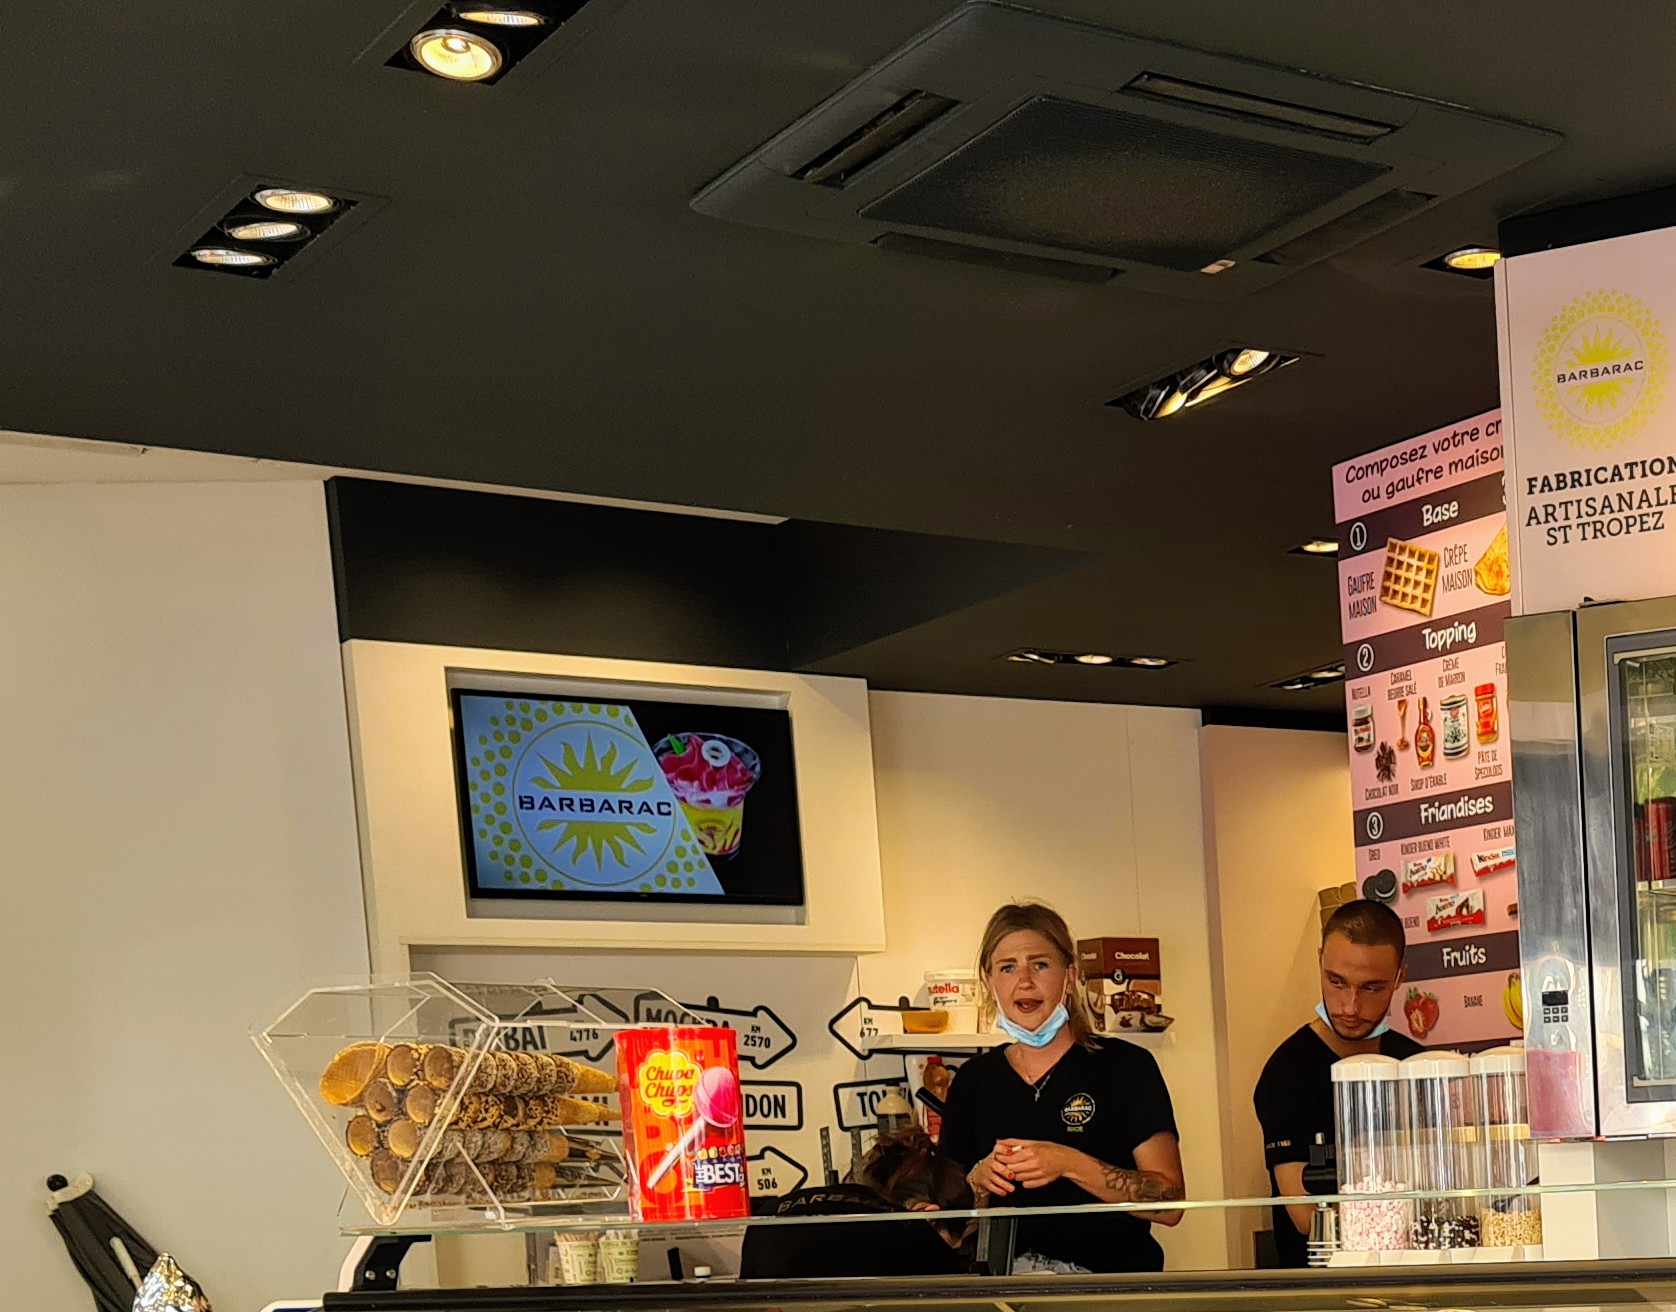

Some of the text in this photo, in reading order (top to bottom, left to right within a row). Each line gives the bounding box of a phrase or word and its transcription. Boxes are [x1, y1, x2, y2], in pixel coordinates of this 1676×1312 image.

[1557, 360, 1644, 384] BARBARAC
[1345, 445, 1427, 484] Composez
[1432, 427, 1480, 455] votre
[1361, 487, 1381, 504] ou
[1386, 468, 1443, 500] gaufre
[1421, 500, 1459, 527] Base
[1546, 510, 1665, 546] ST TROPEZ
[1347, 571, 1375, 597] GAUFRE
[1442, 567, 1473, 594] MAISON
[1349, 596, 1377, 620] MAISON
[1421, 620, 1477, 652] Topping
[518, 795, 672, 817] BARBARAC
[1420, 795, 1494, 826] Friandises
[1442, 946, 1486, 969] Fruits
[751, 1025, 761, 1033] KM
[860, 1028, 878, 1038] 677
[744, 1035, 771, 1048] 2570
[646, 1066, 694, 1082] Chupa
[645, 1082, 693, 1099] Chups
[704, 1164, 740, 1185] BEST
[761, 1167, 772, 1176] KM
[757, 1178, 778, 1190] 506
